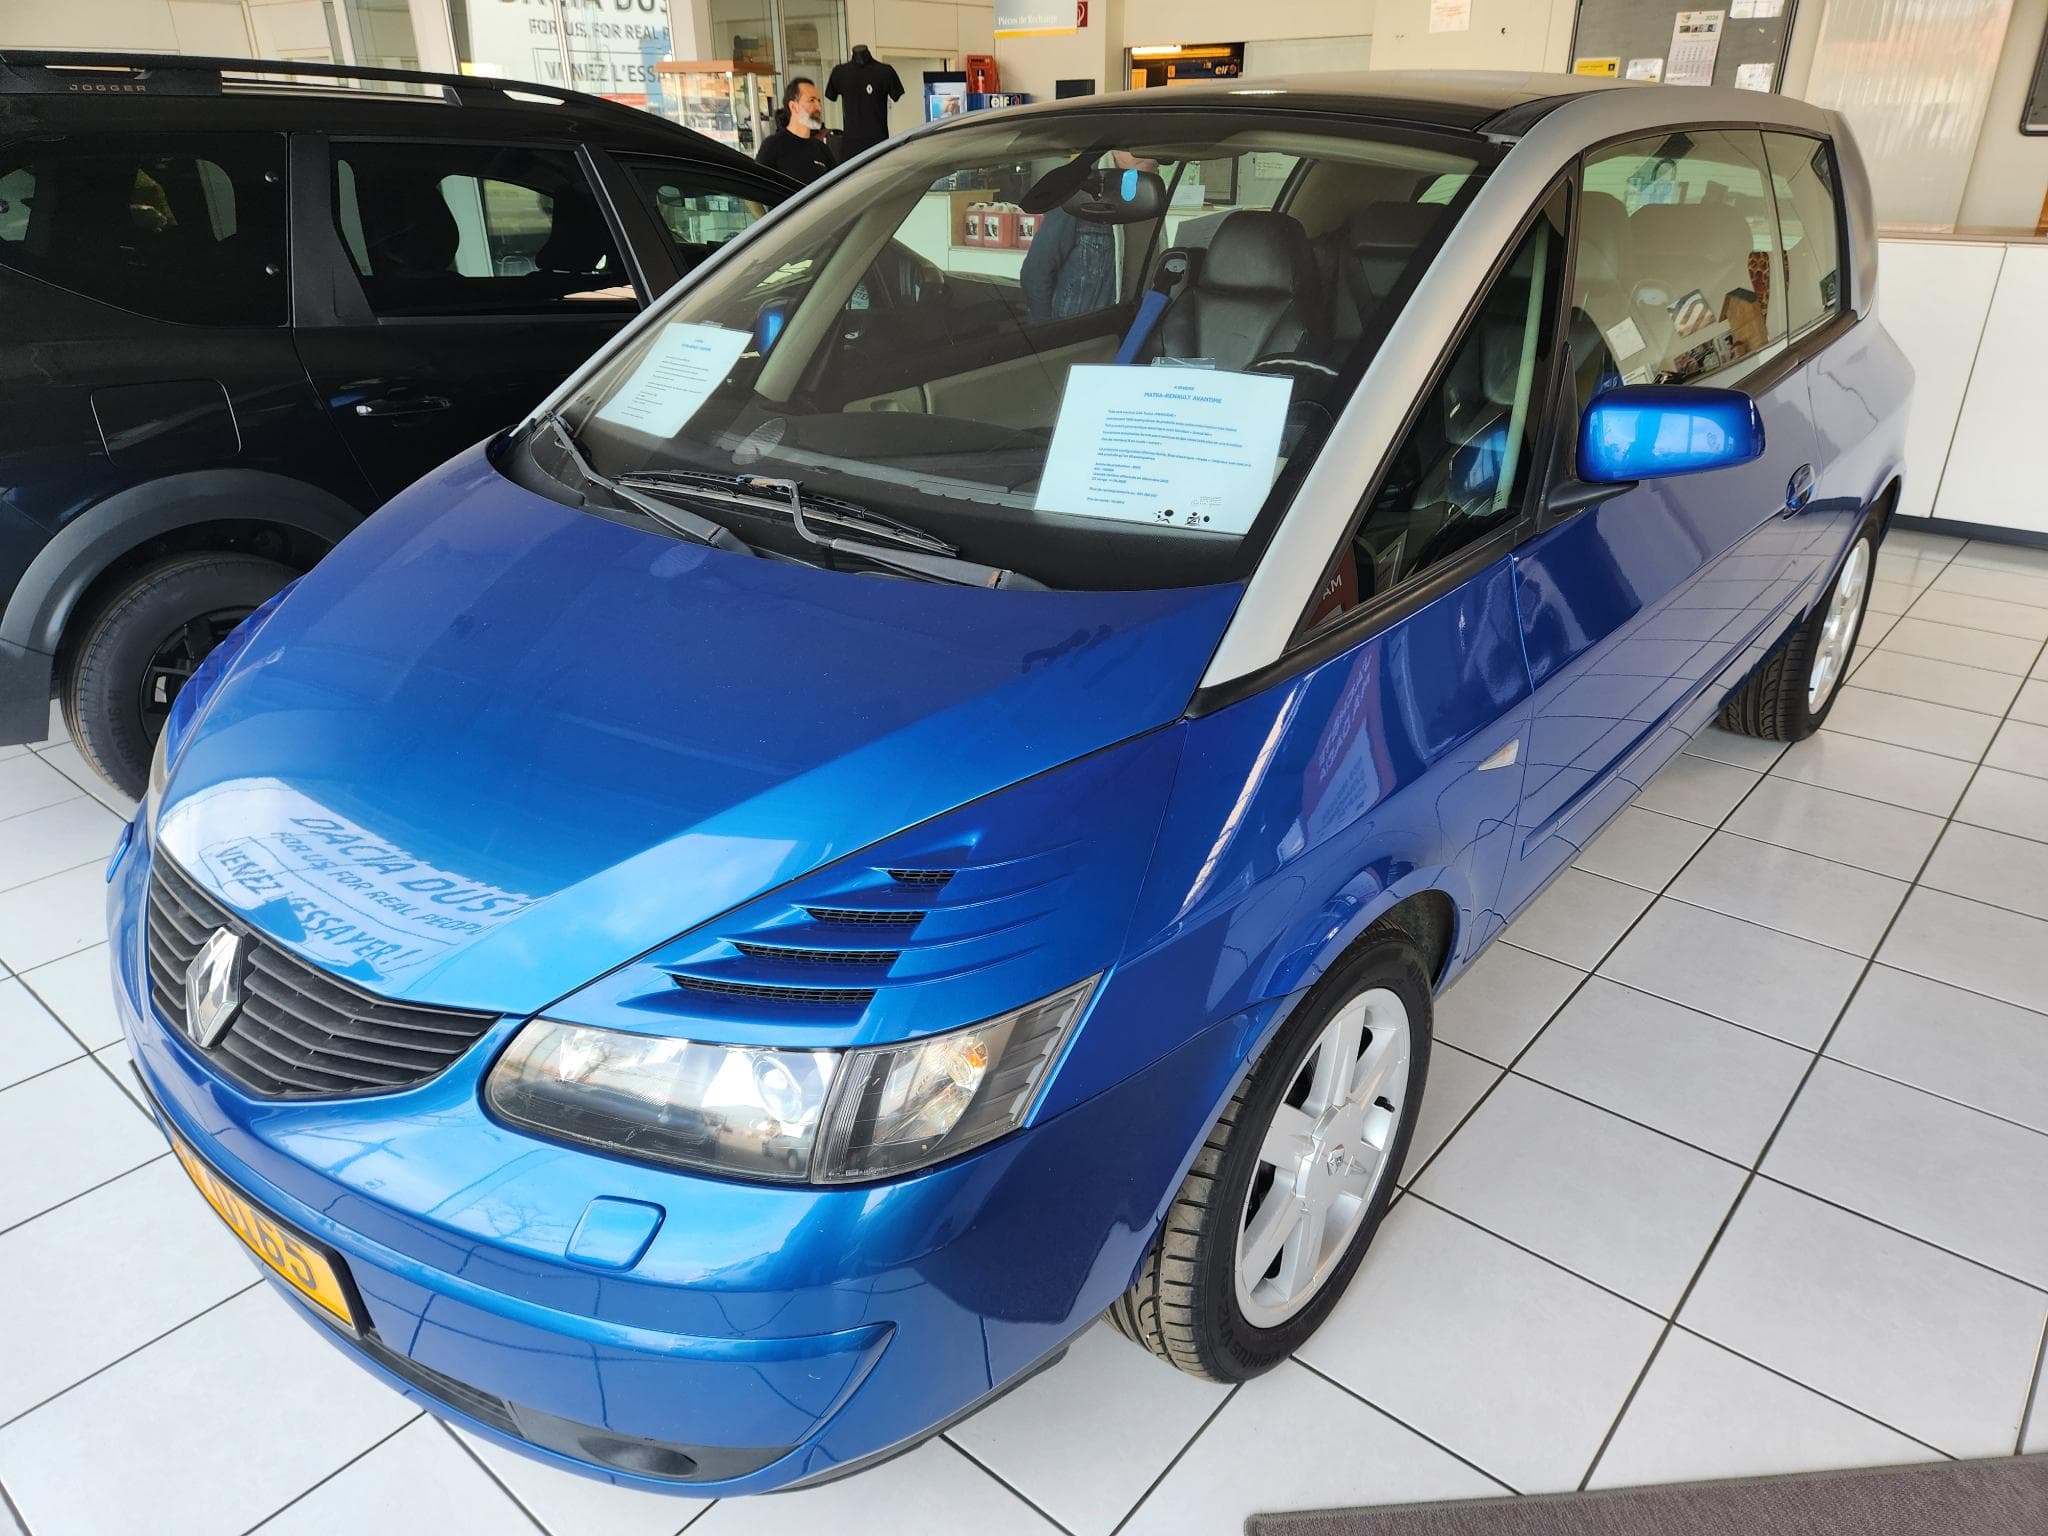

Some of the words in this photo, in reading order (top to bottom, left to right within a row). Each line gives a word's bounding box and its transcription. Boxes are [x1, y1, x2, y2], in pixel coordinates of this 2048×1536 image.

[591, 22, 621, 39] FOR
[624, 24, 660, 40] REAL
[1215, 65, 1229, 75] elf
[70, 84, 146, 92] JOGGER
[991, 95, 1009, 108] elf
[289, 818, 416, 875] DACIA
[216, 845, 284, 895] VENEZ
[327, 871, 374, 890] FOR
[363, 891, 419, 916] REAL
